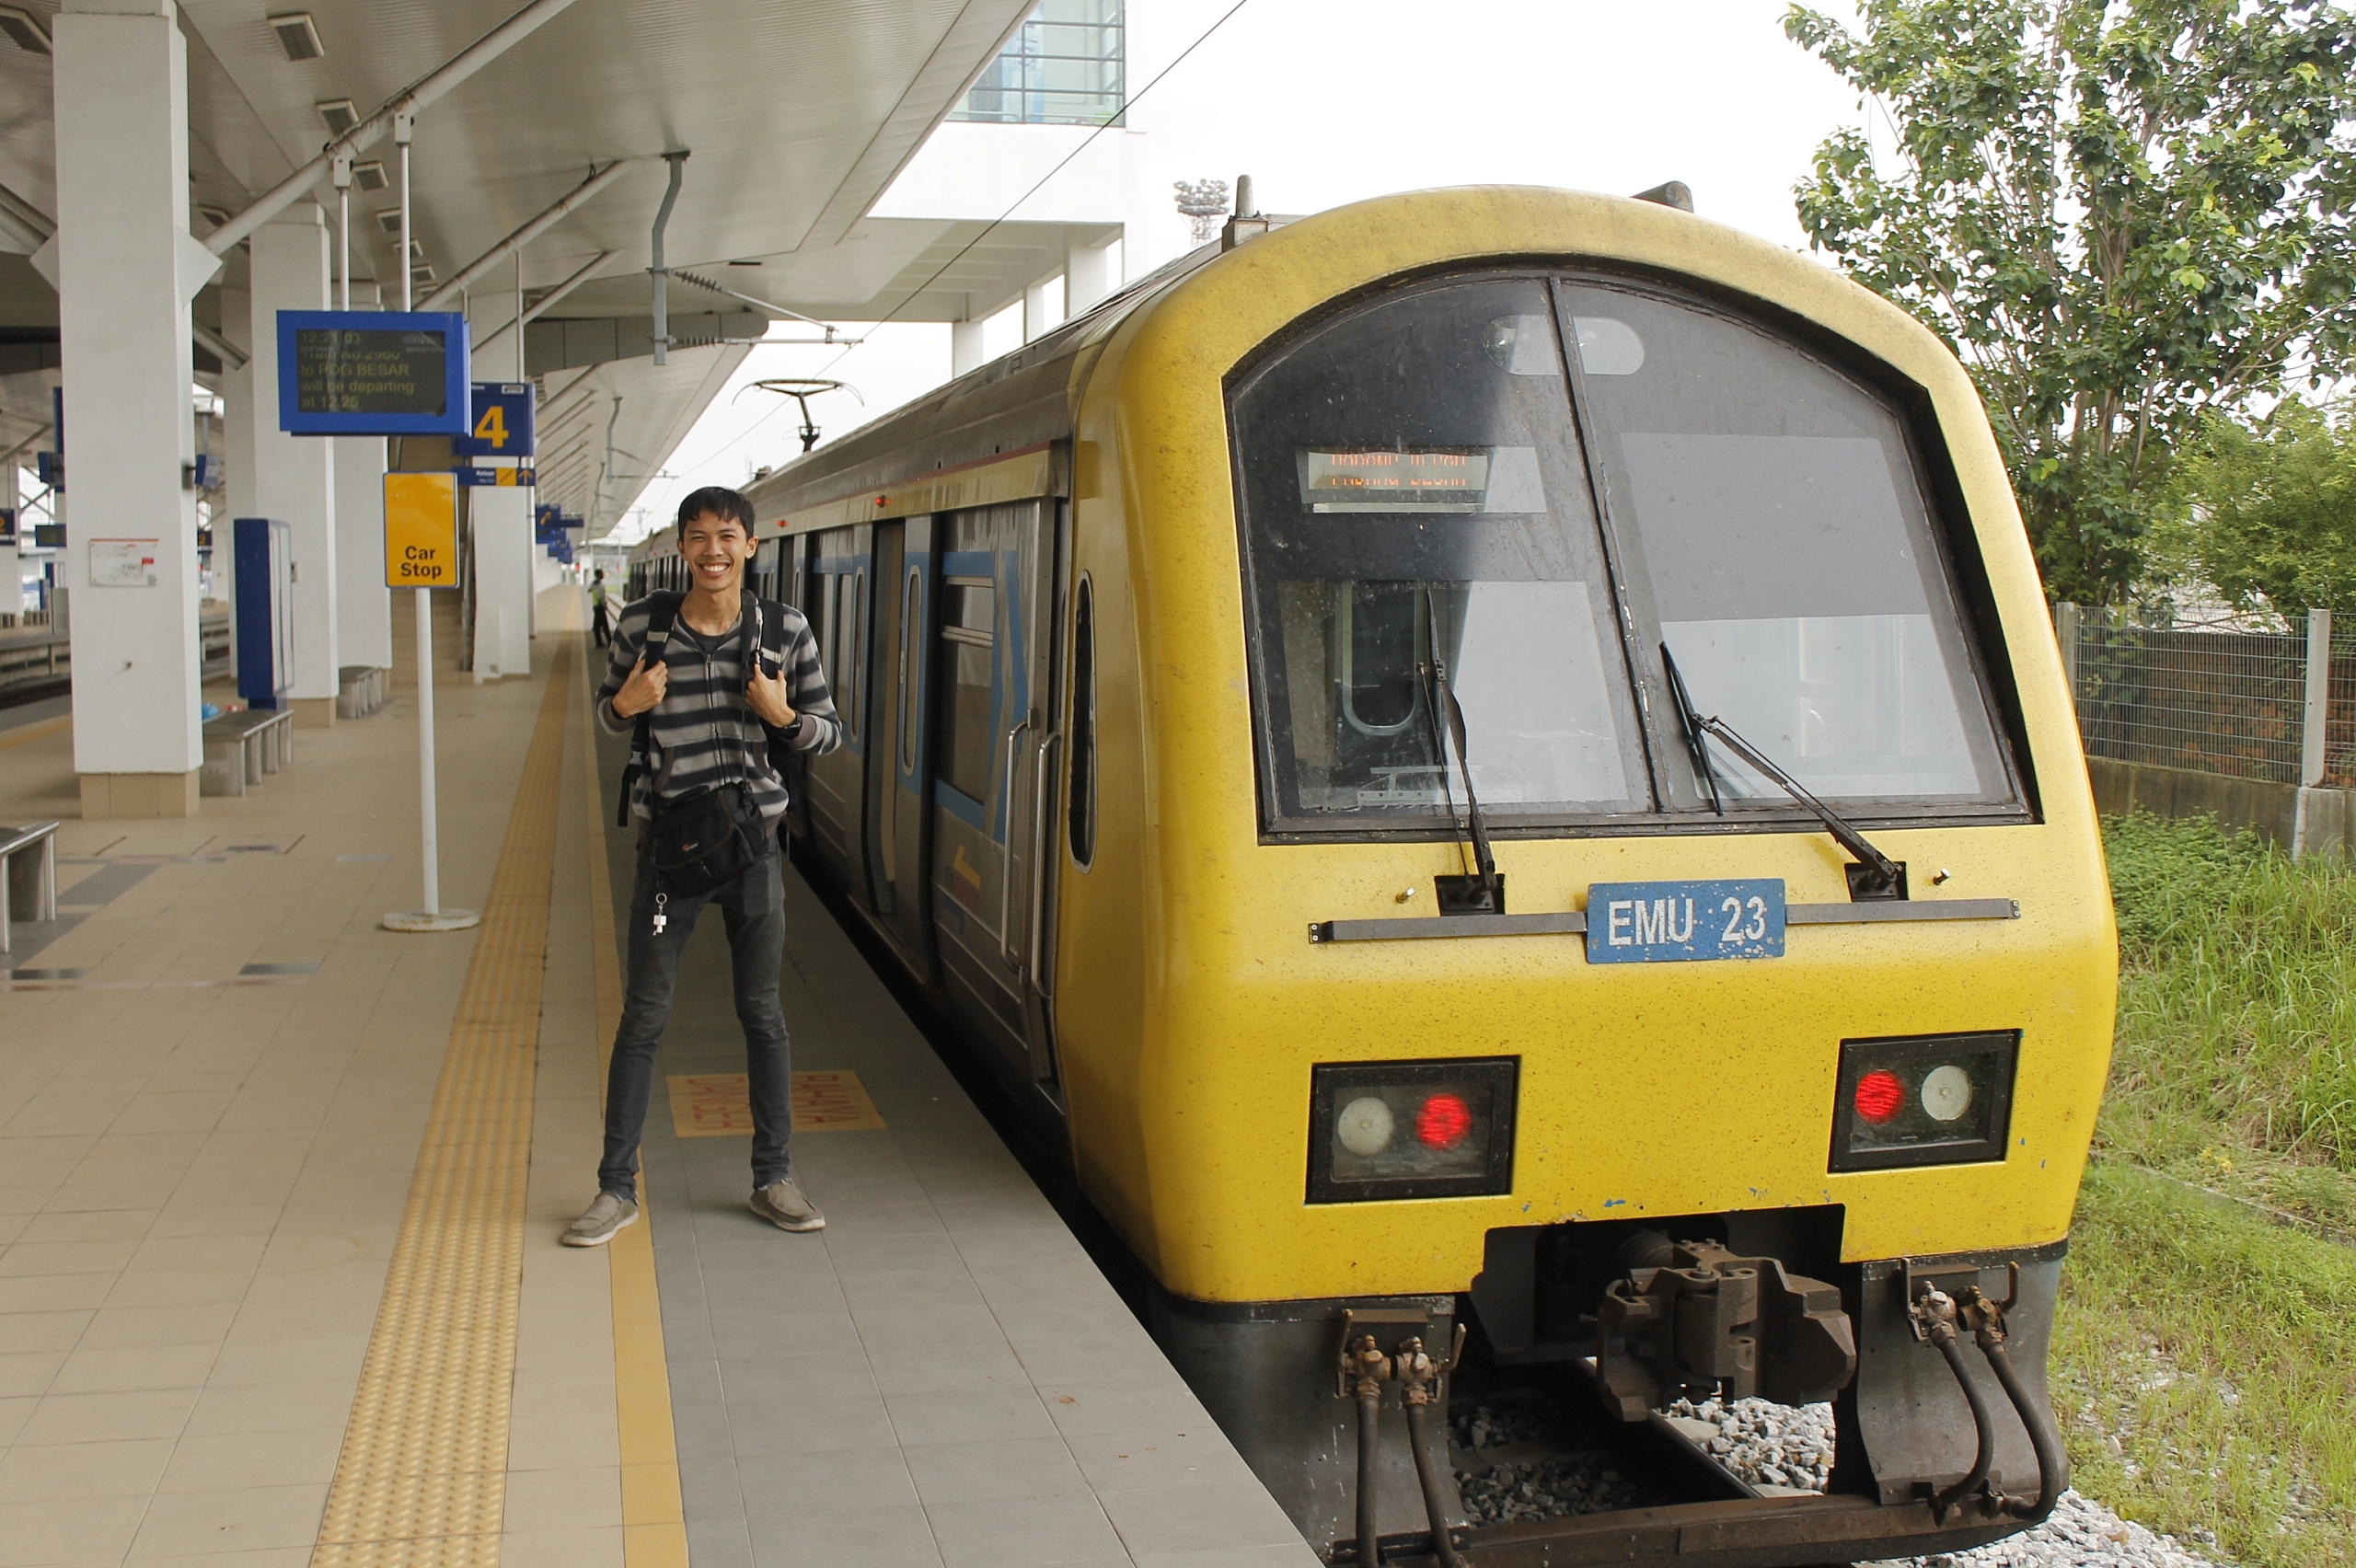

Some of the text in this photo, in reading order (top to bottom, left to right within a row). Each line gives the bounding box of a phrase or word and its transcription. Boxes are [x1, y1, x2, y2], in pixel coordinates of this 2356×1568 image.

[301, 364, 315, 375] to
[302, 379, 414, 396] will be departing
[302, 397, 316, 409] at
[474, 405, 510, 448] 4
[405, 546, 436, 560] Car
[400, 562, 442, 580] Stop
[1608, 895, 1767, 946] EMU 23
